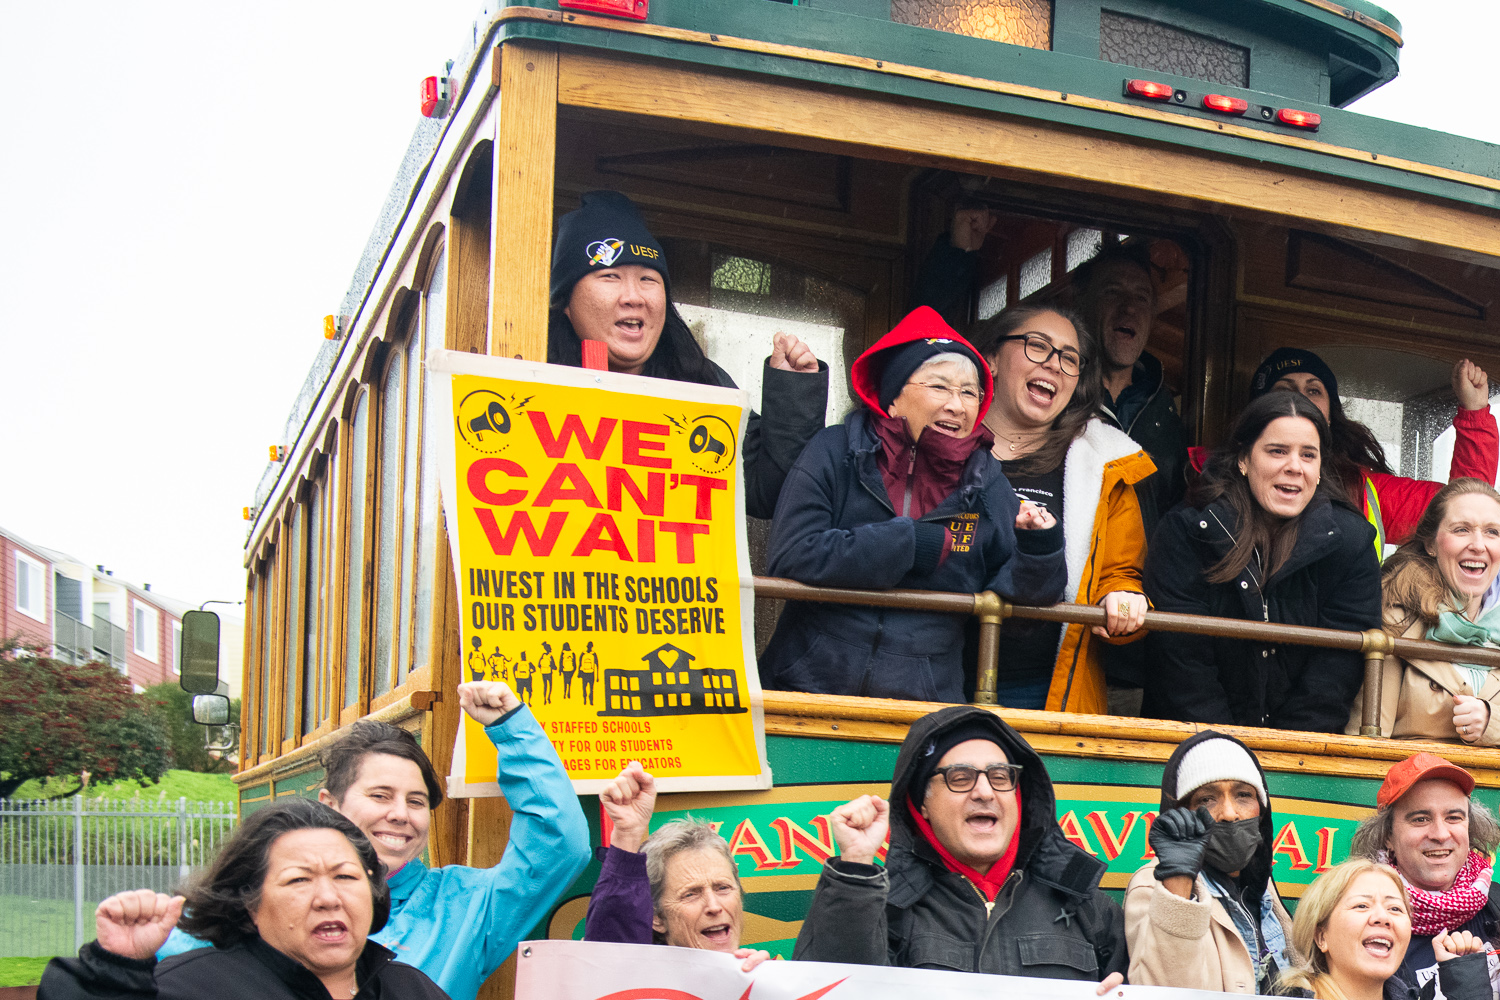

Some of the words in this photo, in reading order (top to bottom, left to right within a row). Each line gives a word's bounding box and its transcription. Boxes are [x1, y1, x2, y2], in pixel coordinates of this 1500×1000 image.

[630, 244, 659, 260] UESF
[1277, 359, 1303, 370] UESF
[526, 410, 672, 469] WE
[466, 457, 728, 520] CAN'T
[1018, 487, 1053, 497] Francisco
[473, 507, 710, 564] WAIT
[469, 568, 544, 599] INVEST
[553, 571, 576, 599] IN
[583, 572, 619, 601] THE
[625, 576, 718, 603] SCHOOLS
[472, 602, 515, 631] OUR
[523, 603, 628, 633] STUDENTS
[636, 607, 725, 635] DESERVE
[552, 721, 598, 734] STAFFED
[602, 720, 651, 734] SCHOOLS
[569, 740, 591, 752] FOR
[595, 740, 616, 752] OUR
[620, 739, 673, 752] STUDENTS
[563, 759, 591, 771] AGES
[595, 758, 616, 770] FOR
[620, 757, 682, 770] ECATORS
